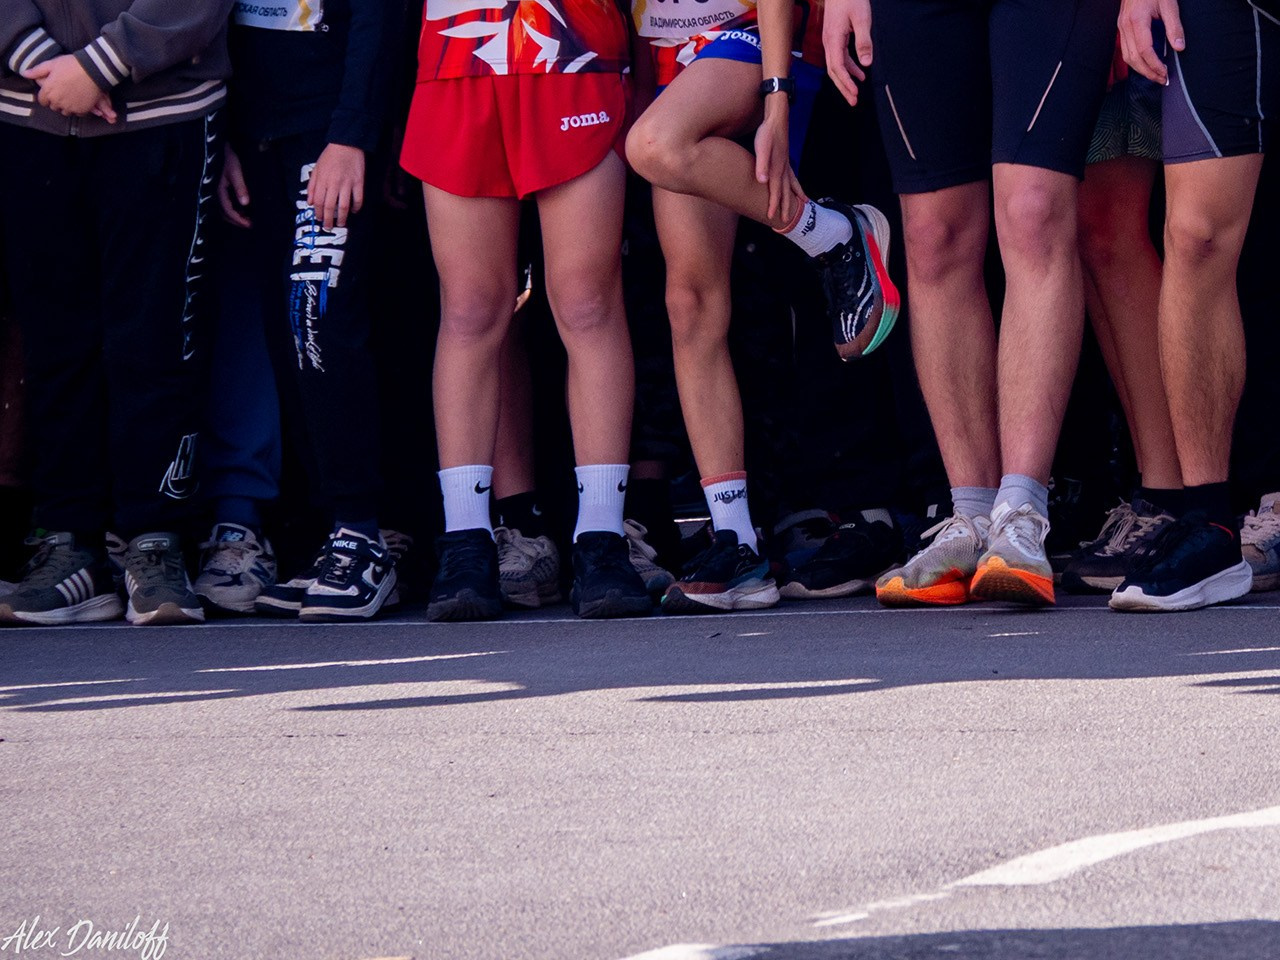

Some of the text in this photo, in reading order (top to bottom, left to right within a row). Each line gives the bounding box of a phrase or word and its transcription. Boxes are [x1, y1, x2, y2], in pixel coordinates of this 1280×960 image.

[258, 5, 288, 17] ОБЛАСТЬ
[698, 11, 735, 26] ОБЛАСТЬ
[714, 490, 736, 502] JUST
[332, 540, 358, 550] NIKE
